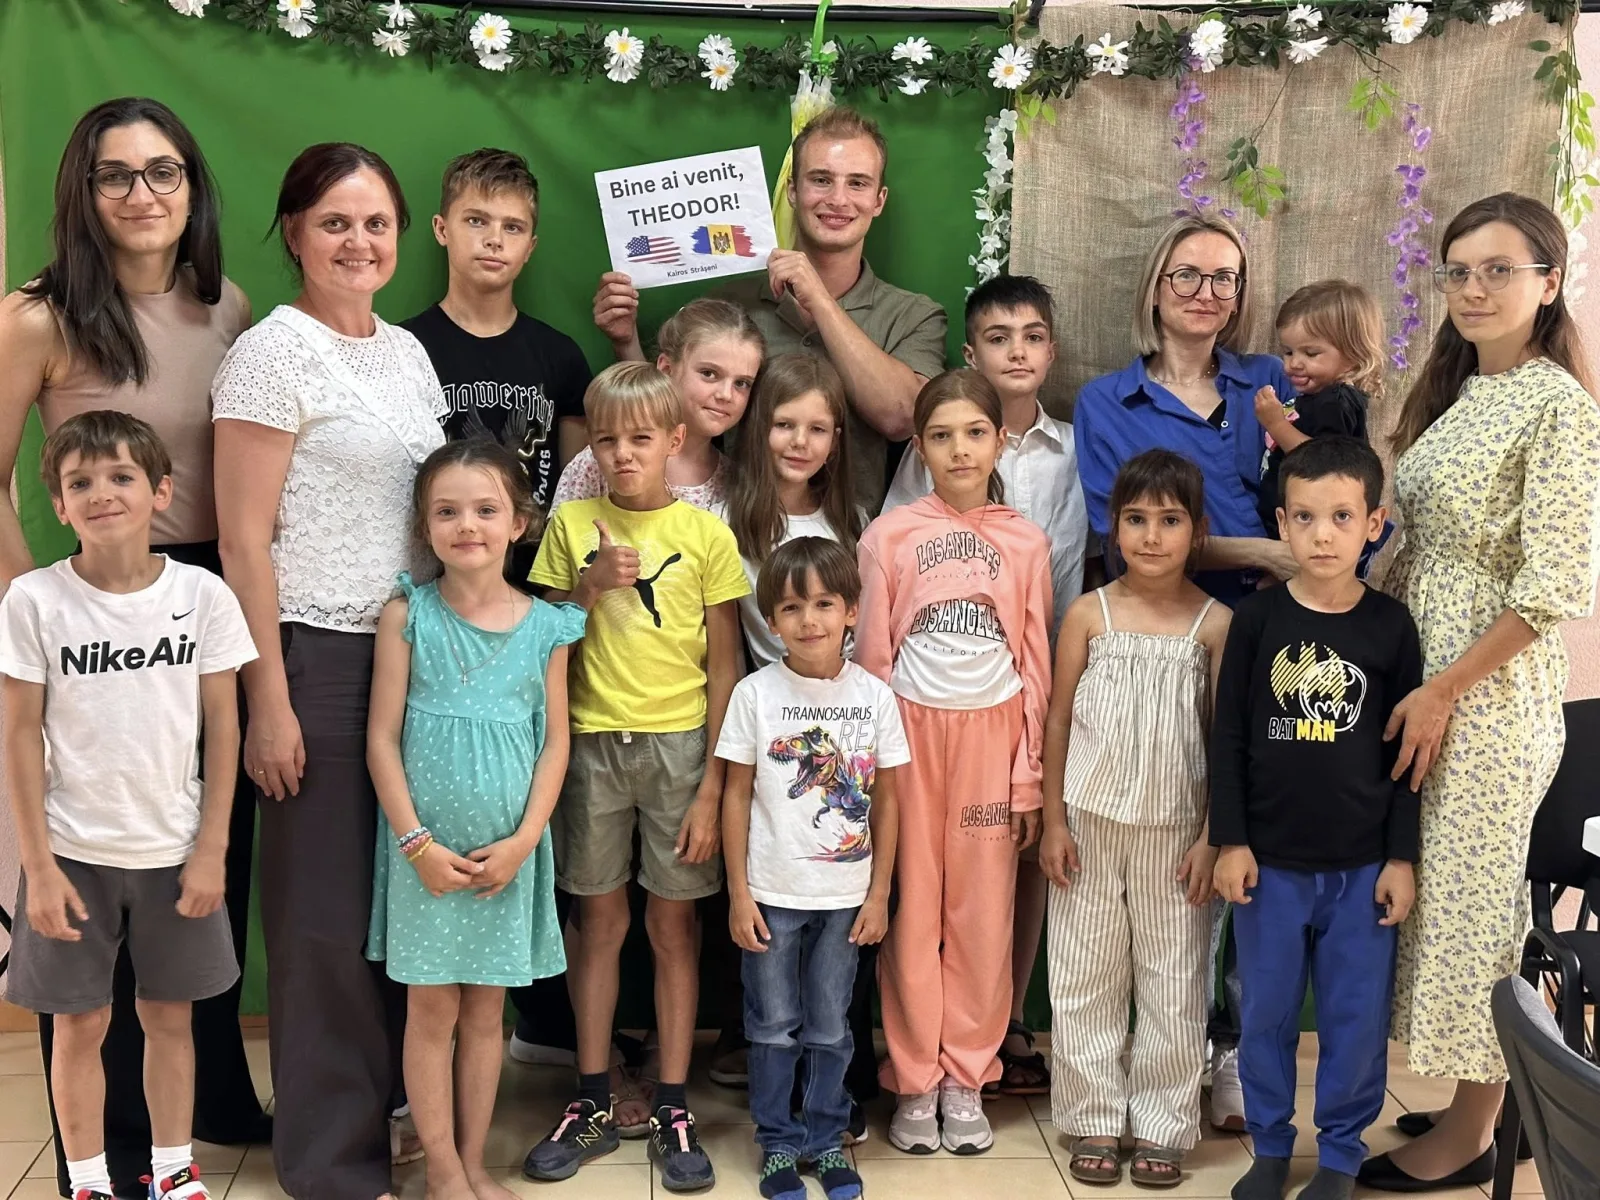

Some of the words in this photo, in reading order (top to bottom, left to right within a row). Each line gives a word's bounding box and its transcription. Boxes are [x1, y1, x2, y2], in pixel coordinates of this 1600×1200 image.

[610, 178, 656, 199] Bine
[661, 170, 680, 191] ai
[684, 162, 744, 187] venit,
[628, 193, 741, 227] THEODOR!
[666, 269, 688, 278] Kairos
[916, 537, 945, 575] LOS
[944, 531, 1001, 581] ANGELES
[938, 598, 1006, 643] ANGELE
[781, 705, 872, 721] TYRANNOSAURUS
[960, 805, 984, 828] LOS
